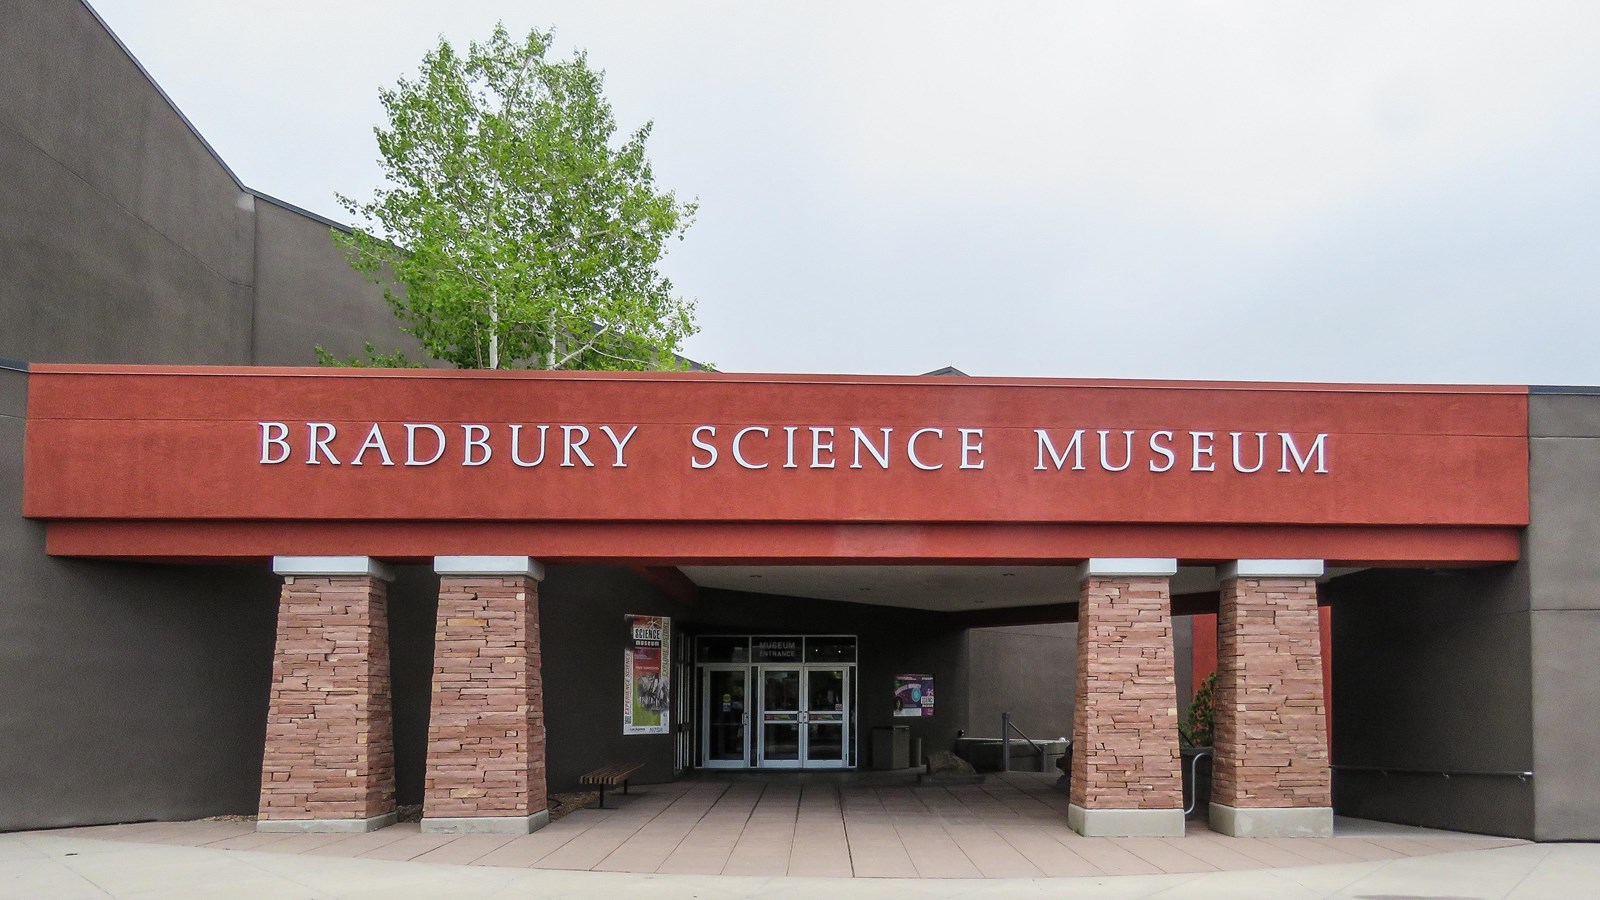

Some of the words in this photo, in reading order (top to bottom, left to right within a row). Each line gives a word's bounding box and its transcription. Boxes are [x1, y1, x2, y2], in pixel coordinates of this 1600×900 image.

[258, 421, 637, 468] BRADBURY
[691, 425, 985, 470] SCIENCE
[1033, 428, 1328, 474] MUSEUM
[635, 628, 660, 639] SCIENCE
[759, 641, 796, 649] MUSEUM
